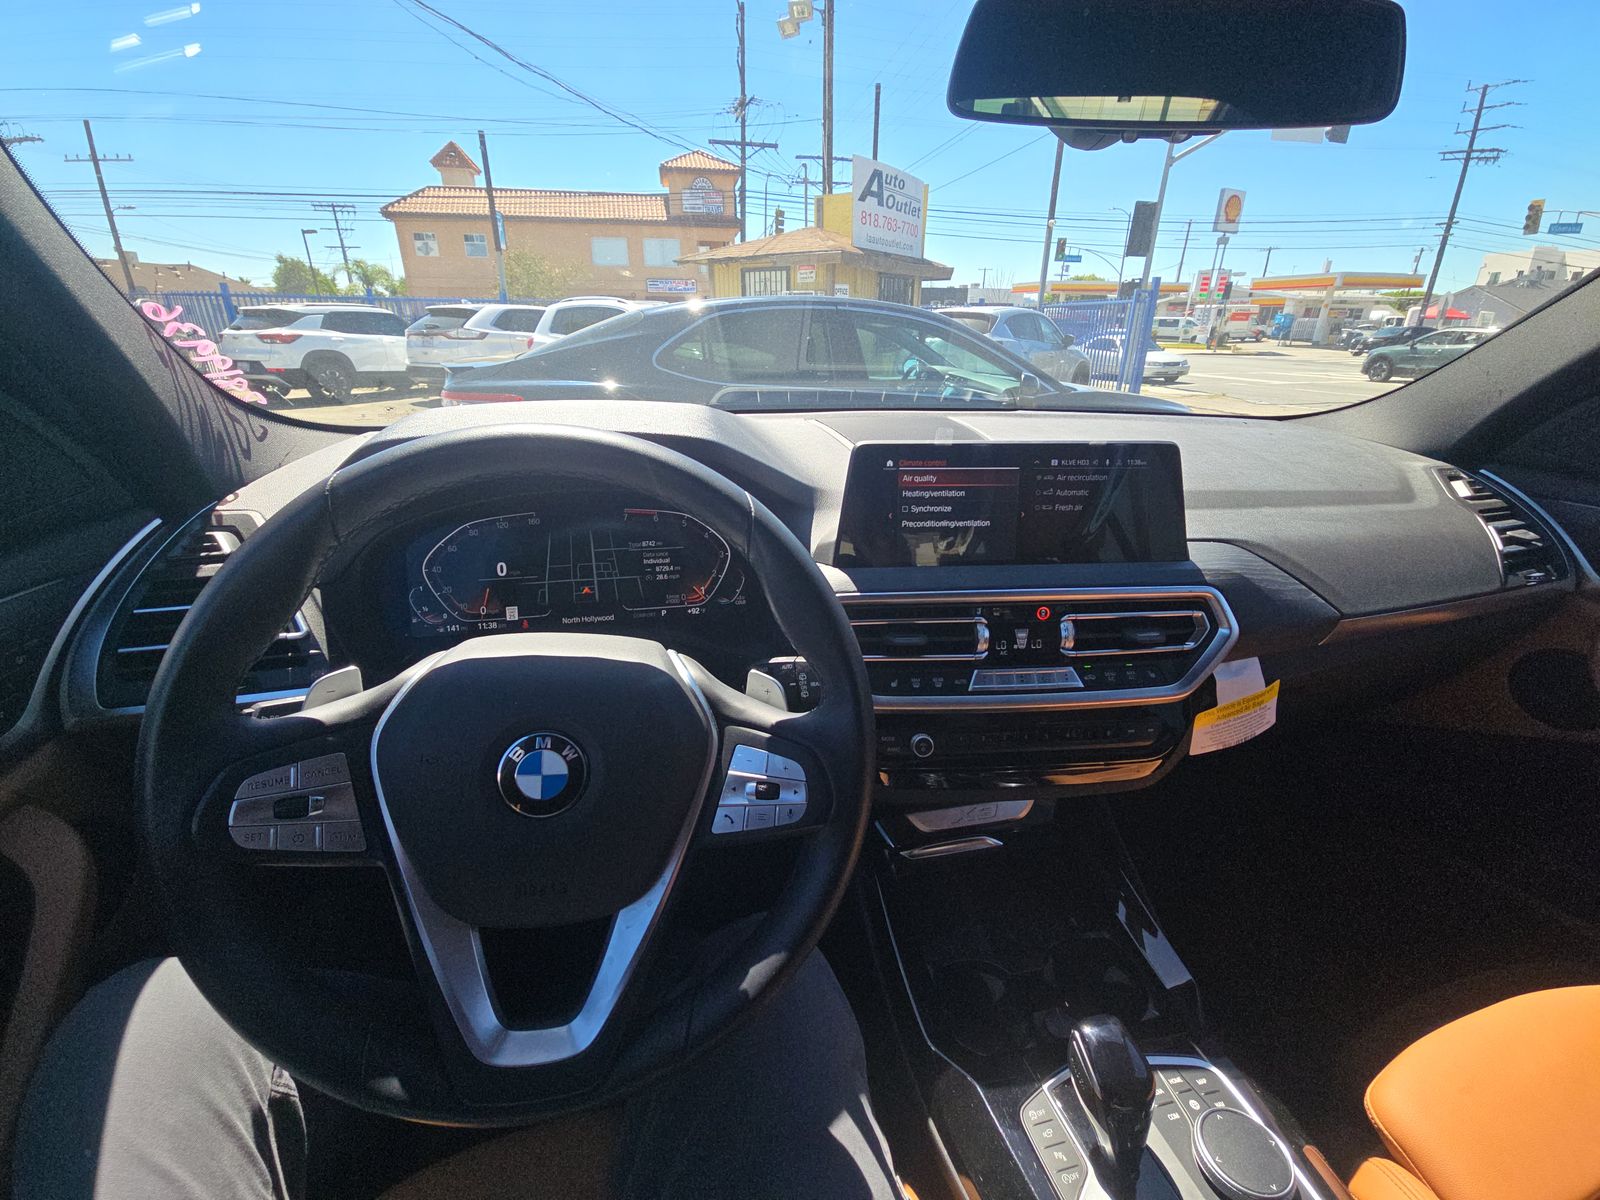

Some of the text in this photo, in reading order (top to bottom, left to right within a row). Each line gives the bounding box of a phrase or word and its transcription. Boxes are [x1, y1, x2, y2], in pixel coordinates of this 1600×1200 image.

[858, 169, 906, 208] Auto
[885, 194, 922, 219] Outlet
[899, 459, 947, 467] Climate control
[902, 474, 937, 483] Air quality
[902, 490, 966, 499] Heating/ventilation
[910, 505, 953, 514] Synchronize
[495, 521, 509, 529] 120
[902, 519, 991, 529] Preconditioning/ventilation
[643, 557, 671, 565] Individual
[496, 561, 507, 577] 0
[442, 586, 452, 594] 20
[480, 605, 487, 615] 0
[661, 609, 667, 617] P
[562, 614, 614, 625] North Hollywood
[446, 624, 460, 632] 141
[477, 622, 498, 630] 11:38
[508, 736, 579, 763] BMW
[247, 777, 290, 790] RESUME
[244, 832, 264, 841] SET
[1167, 1076, 1184, 1085] HOME
[1195, 1078, 1207, 1086] MAP
[1037, 1108, 1047, 1117] OFF
[1167, 1112, 1181, 1121] COM
[1071, 1171, 1081, 1181] OFF
